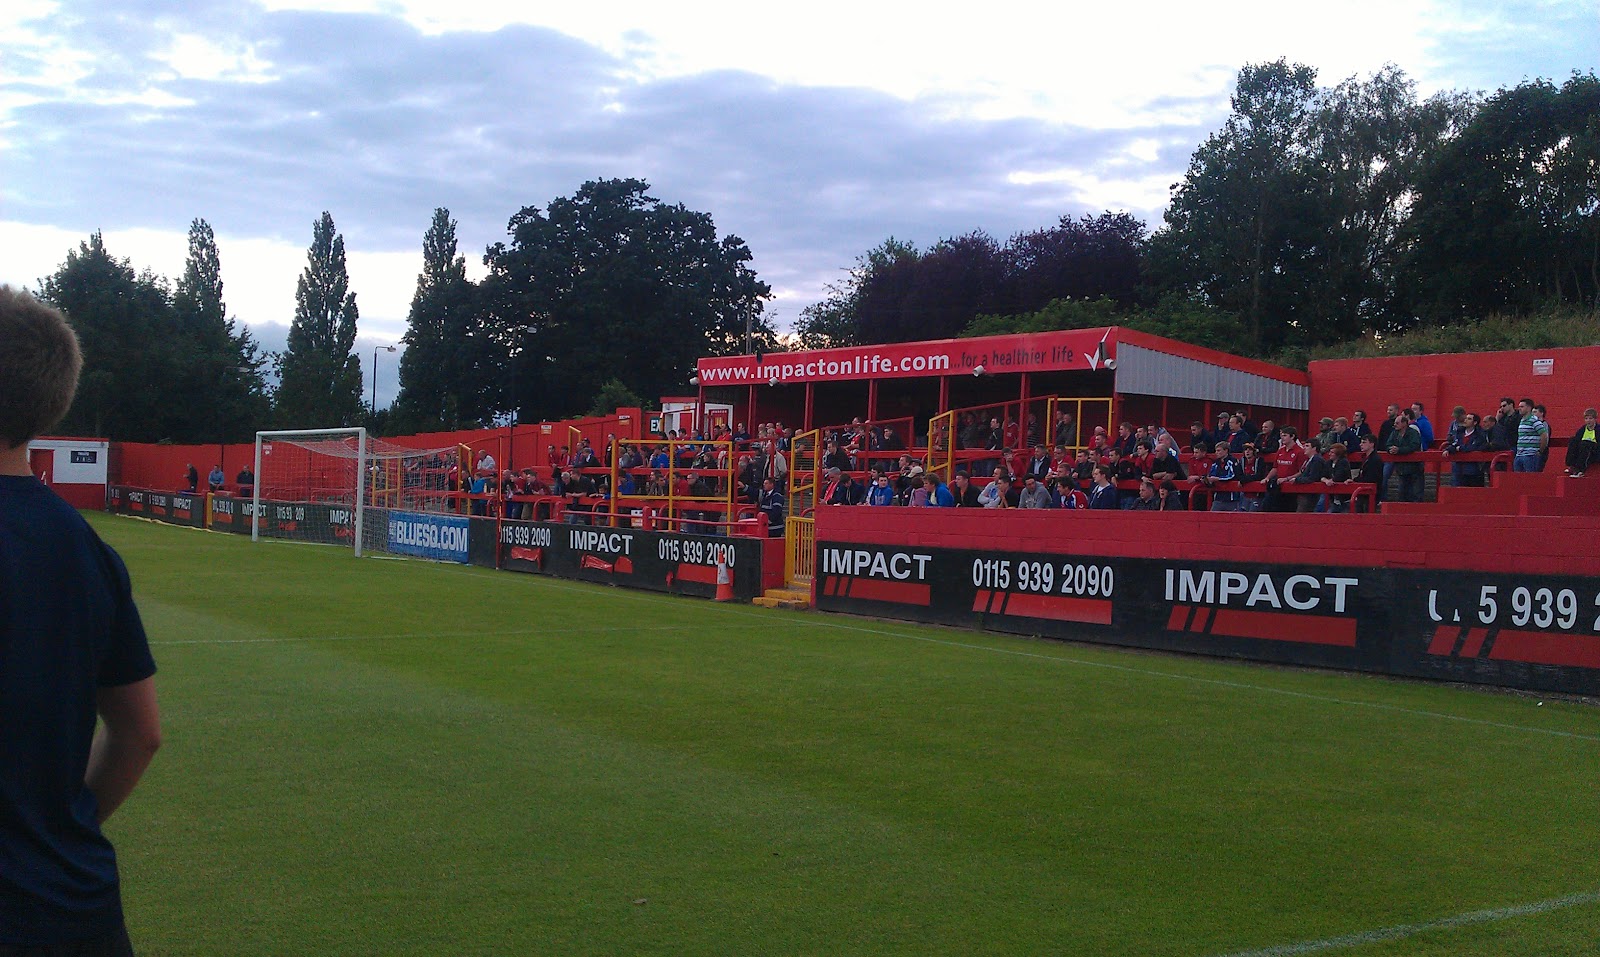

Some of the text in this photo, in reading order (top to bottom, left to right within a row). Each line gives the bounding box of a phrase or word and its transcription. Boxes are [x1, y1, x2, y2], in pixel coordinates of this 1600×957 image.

[701, 352, 949, 381] www.impactonlife.com
[981, 352, 988, 367] a
[992, 347, 1047, 367] healthier
[1052, 345, 1074, 363] life
[242, 502, 267, 517] IMPCT
[396, 520, 468, 553] BLUESQ.COM
[514, 525, 529, 545] 939
[531, 527, 551, 547] 2090
[569, 529, 634, 555] IMPACT
[658, 538, 679, 561] 0115
[683, 540, 702, 564] 939
[822, 548, 932, 580] IMPACT
[972, 557, 1114, 597] 0115 939 2090
[1165, 568, 1359, 613] IMPACT
[1511, 586, 1577, 630] 939
